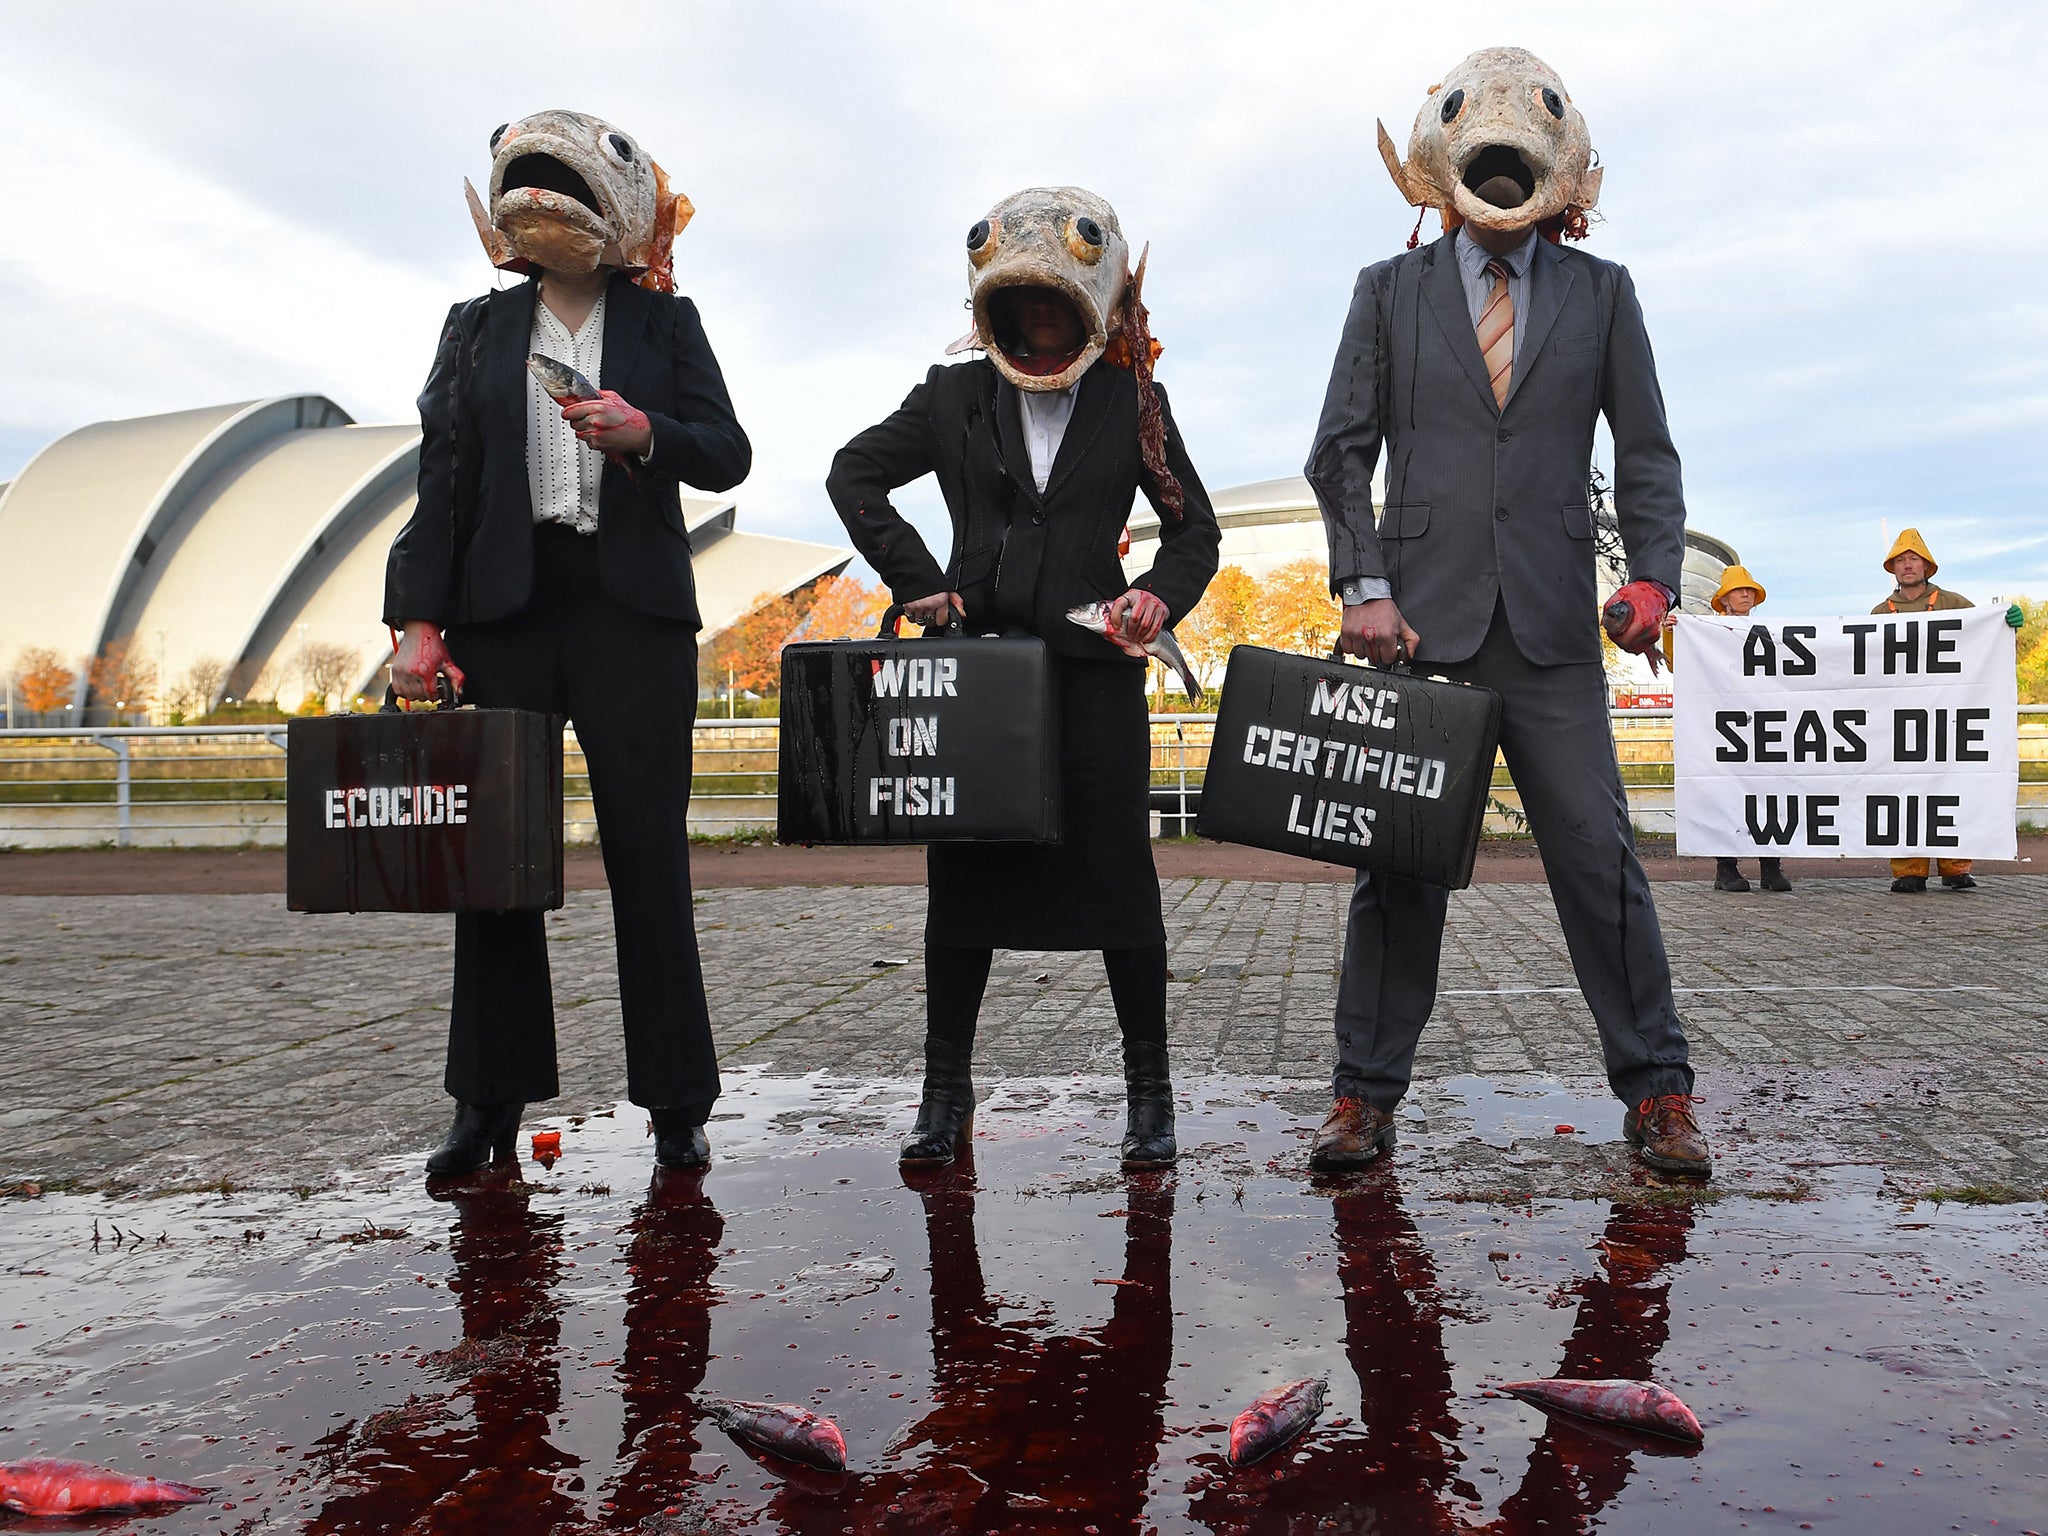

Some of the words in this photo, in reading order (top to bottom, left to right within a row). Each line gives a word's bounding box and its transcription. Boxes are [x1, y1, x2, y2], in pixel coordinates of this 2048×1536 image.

[1743, 624, 1817, 677] AS
[1842, 619, 1963, 676] THE
[870, 657, 958, 698] WAR
[1309, 677, 1399, 730] MSC
[887, 716, 938, 757] ON
[1242, 724, 1446, 800] CERTIFIED
[1715, 709, 1867, 763] SEAS
[1893, 708, 1990, 762] DIE
[325, 784, 468, 829] ECOCIDE
[869, 776, 955, 816] FISH
[1286, 793, 1378, 847] LIES
[1744, 794, 1840, 847] WE
[1865, 794, 1960, 847] DIE
